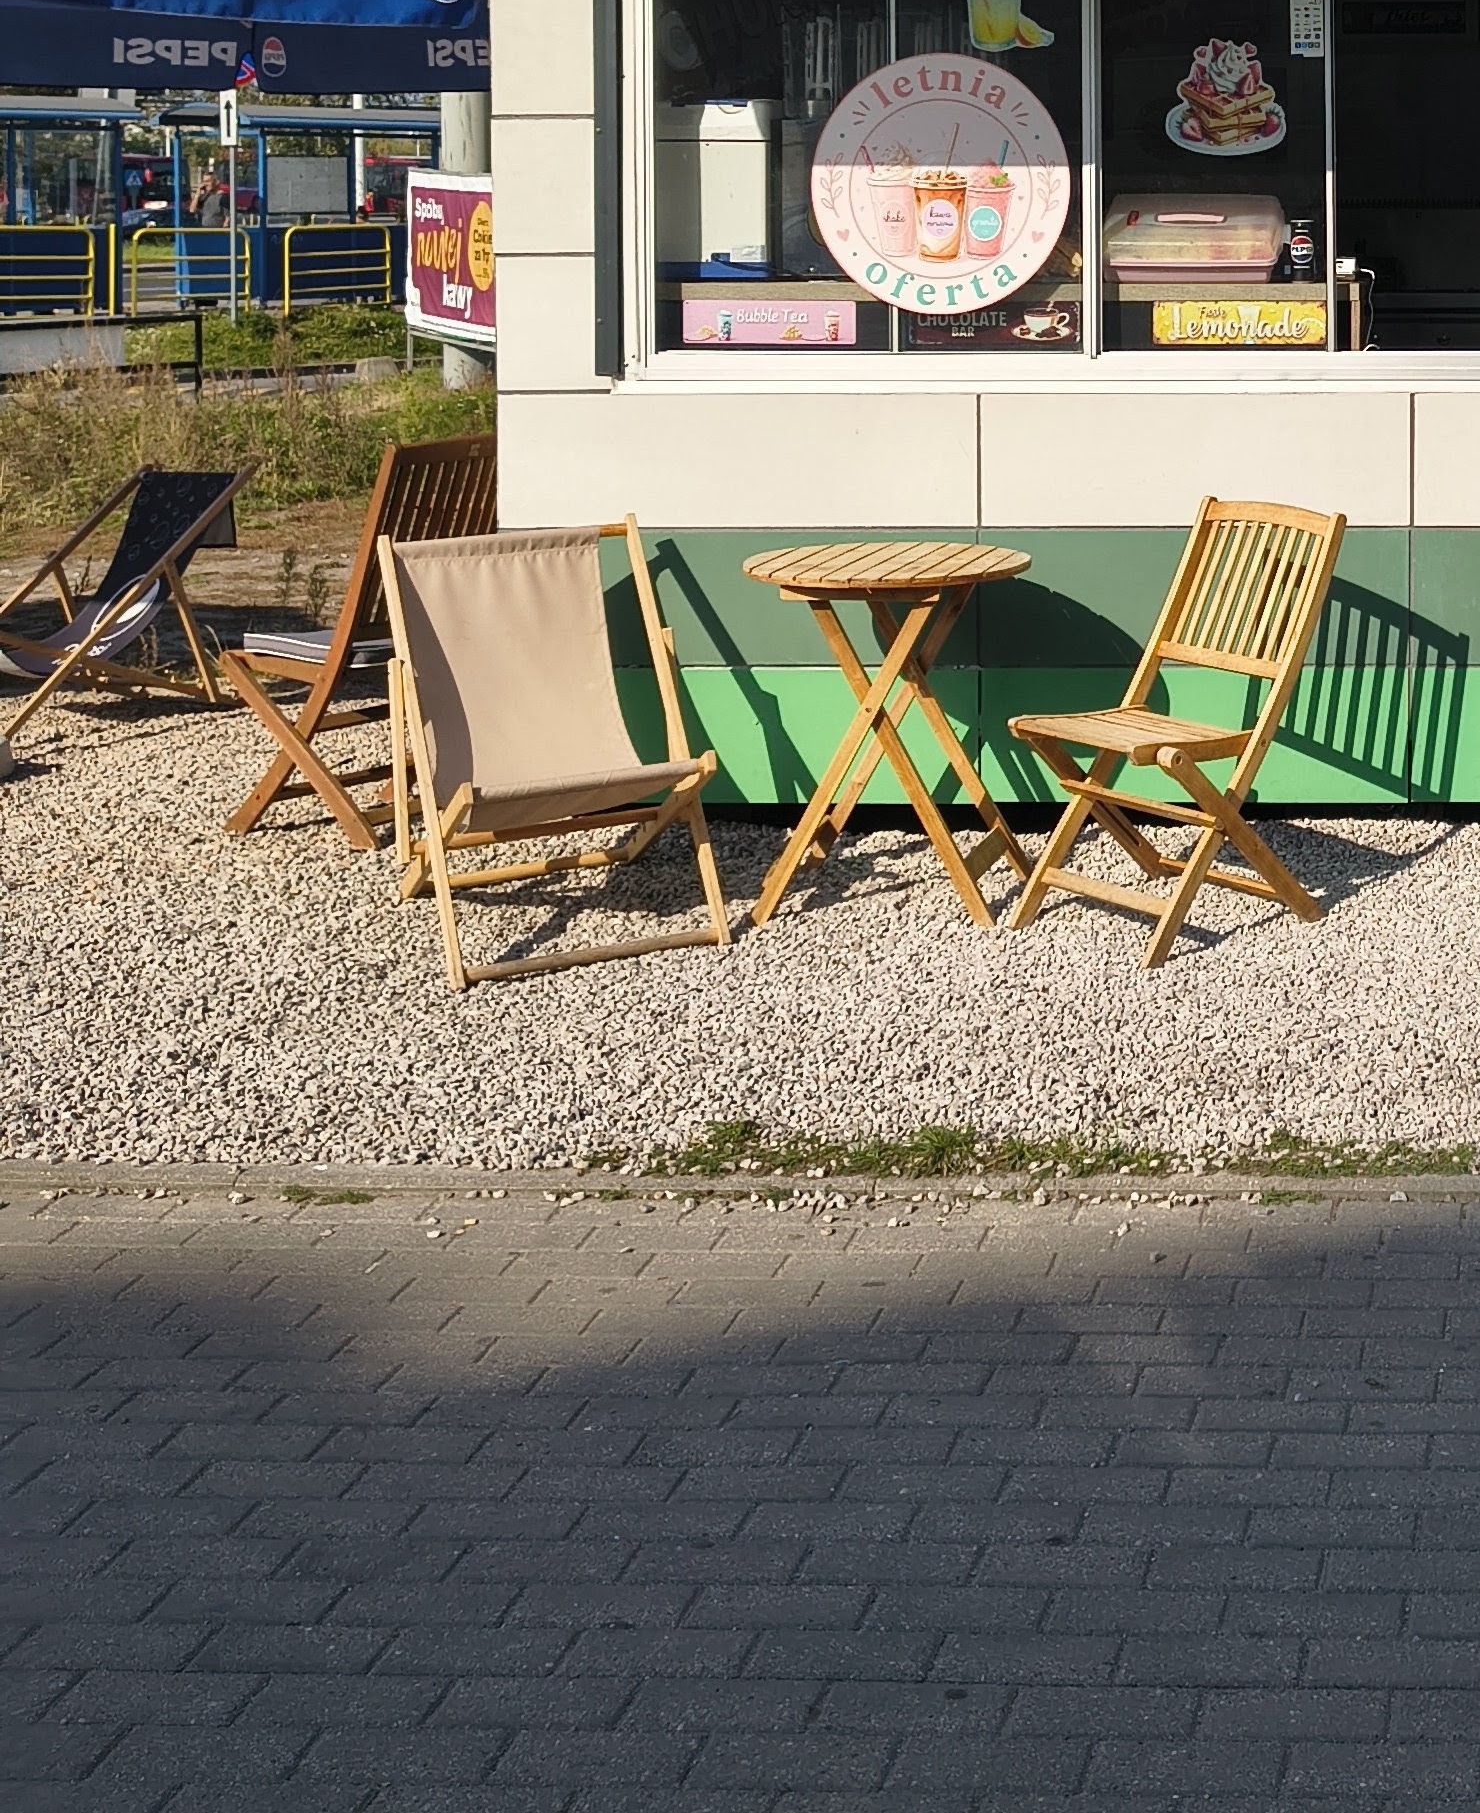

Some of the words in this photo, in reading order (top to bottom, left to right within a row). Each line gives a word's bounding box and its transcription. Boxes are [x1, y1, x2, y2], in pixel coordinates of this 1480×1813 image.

[869, 65, 1007, 110] letnia
[442, 273, 473, 319] kawy
[865, 261, 1018, 306] oferta
[736, 308, 780, 324] Bubble
[782, 309, 809, 323] Tea
[952, 327, 974, 337] BAR
[1168, 304, 1308, 341] Lemonade
